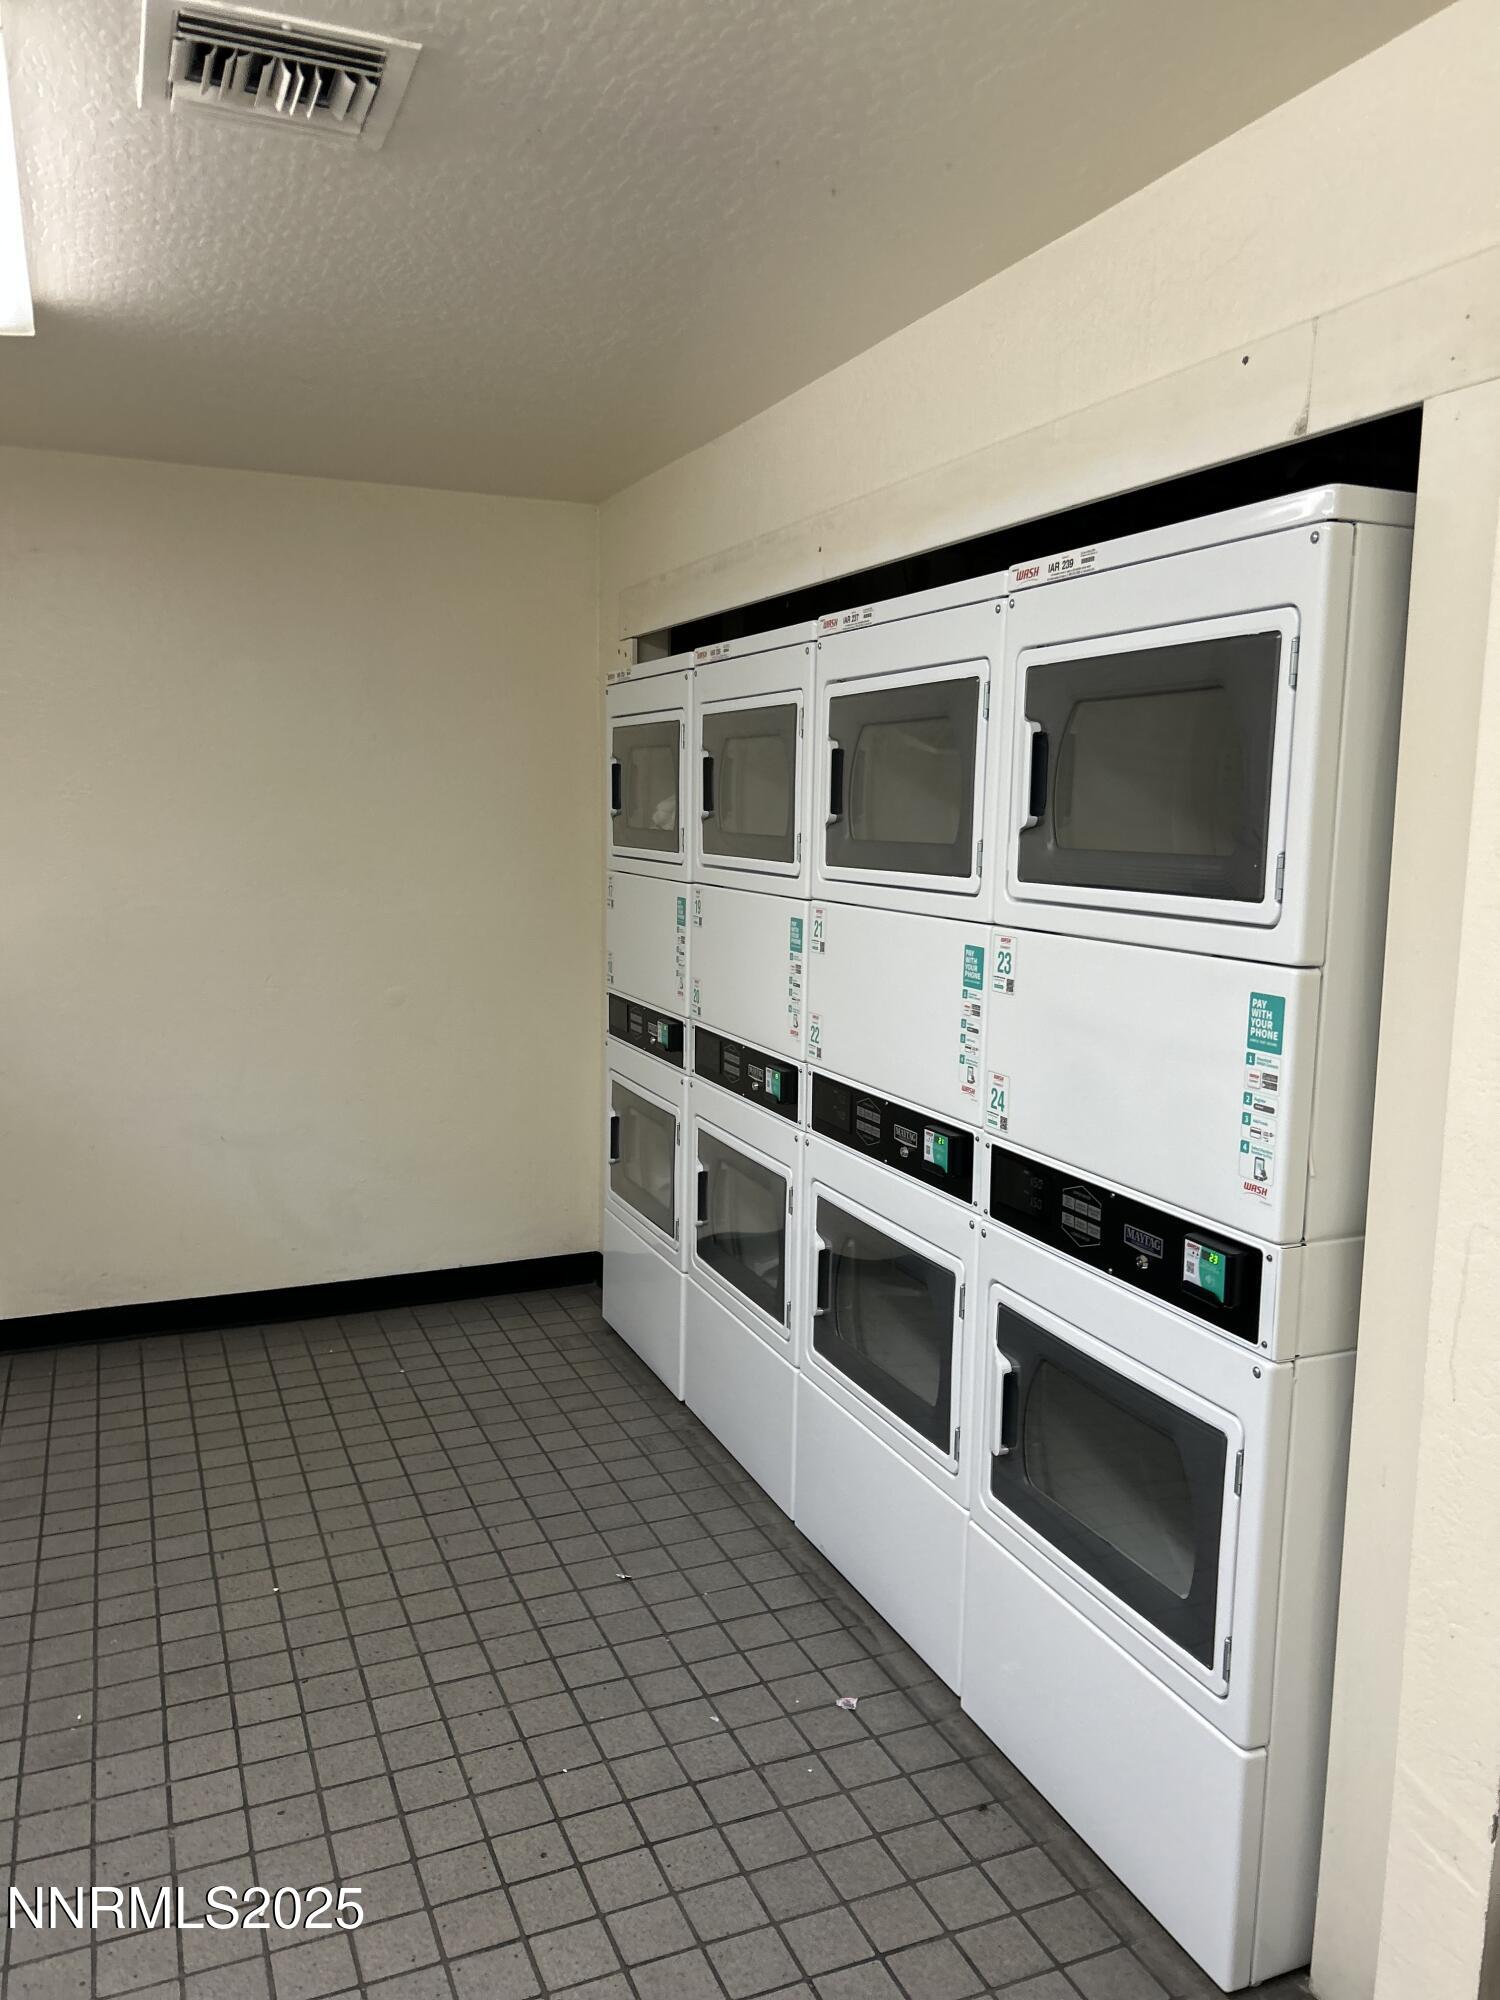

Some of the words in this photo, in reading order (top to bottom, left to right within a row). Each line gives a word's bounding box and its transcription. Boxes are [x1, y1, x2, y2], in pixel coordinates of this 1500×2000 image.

[1061, 559, 1074, 571] 239
[1016, 567, 1040, 581] WASH
[814, 919, 823, 939] 21
[997, 950, 1012, 975] 23
[1252, 998, 1268, 1009] PAY
[1251, 1007, 1273, 1020] WITH
[1250, 1016, 1273, 1031] YOUR
[810, 1025, 820, 1044] 22
[1250, 1026, 1279, 1041] PHONE
[991, 1087, 1005, 1113] 24
[1243, 1181, 1268, 1197] WASH
[1126, 1226, 1162, 1252] MAYTAG
[1208, 1251, 1219, 1265] 23
